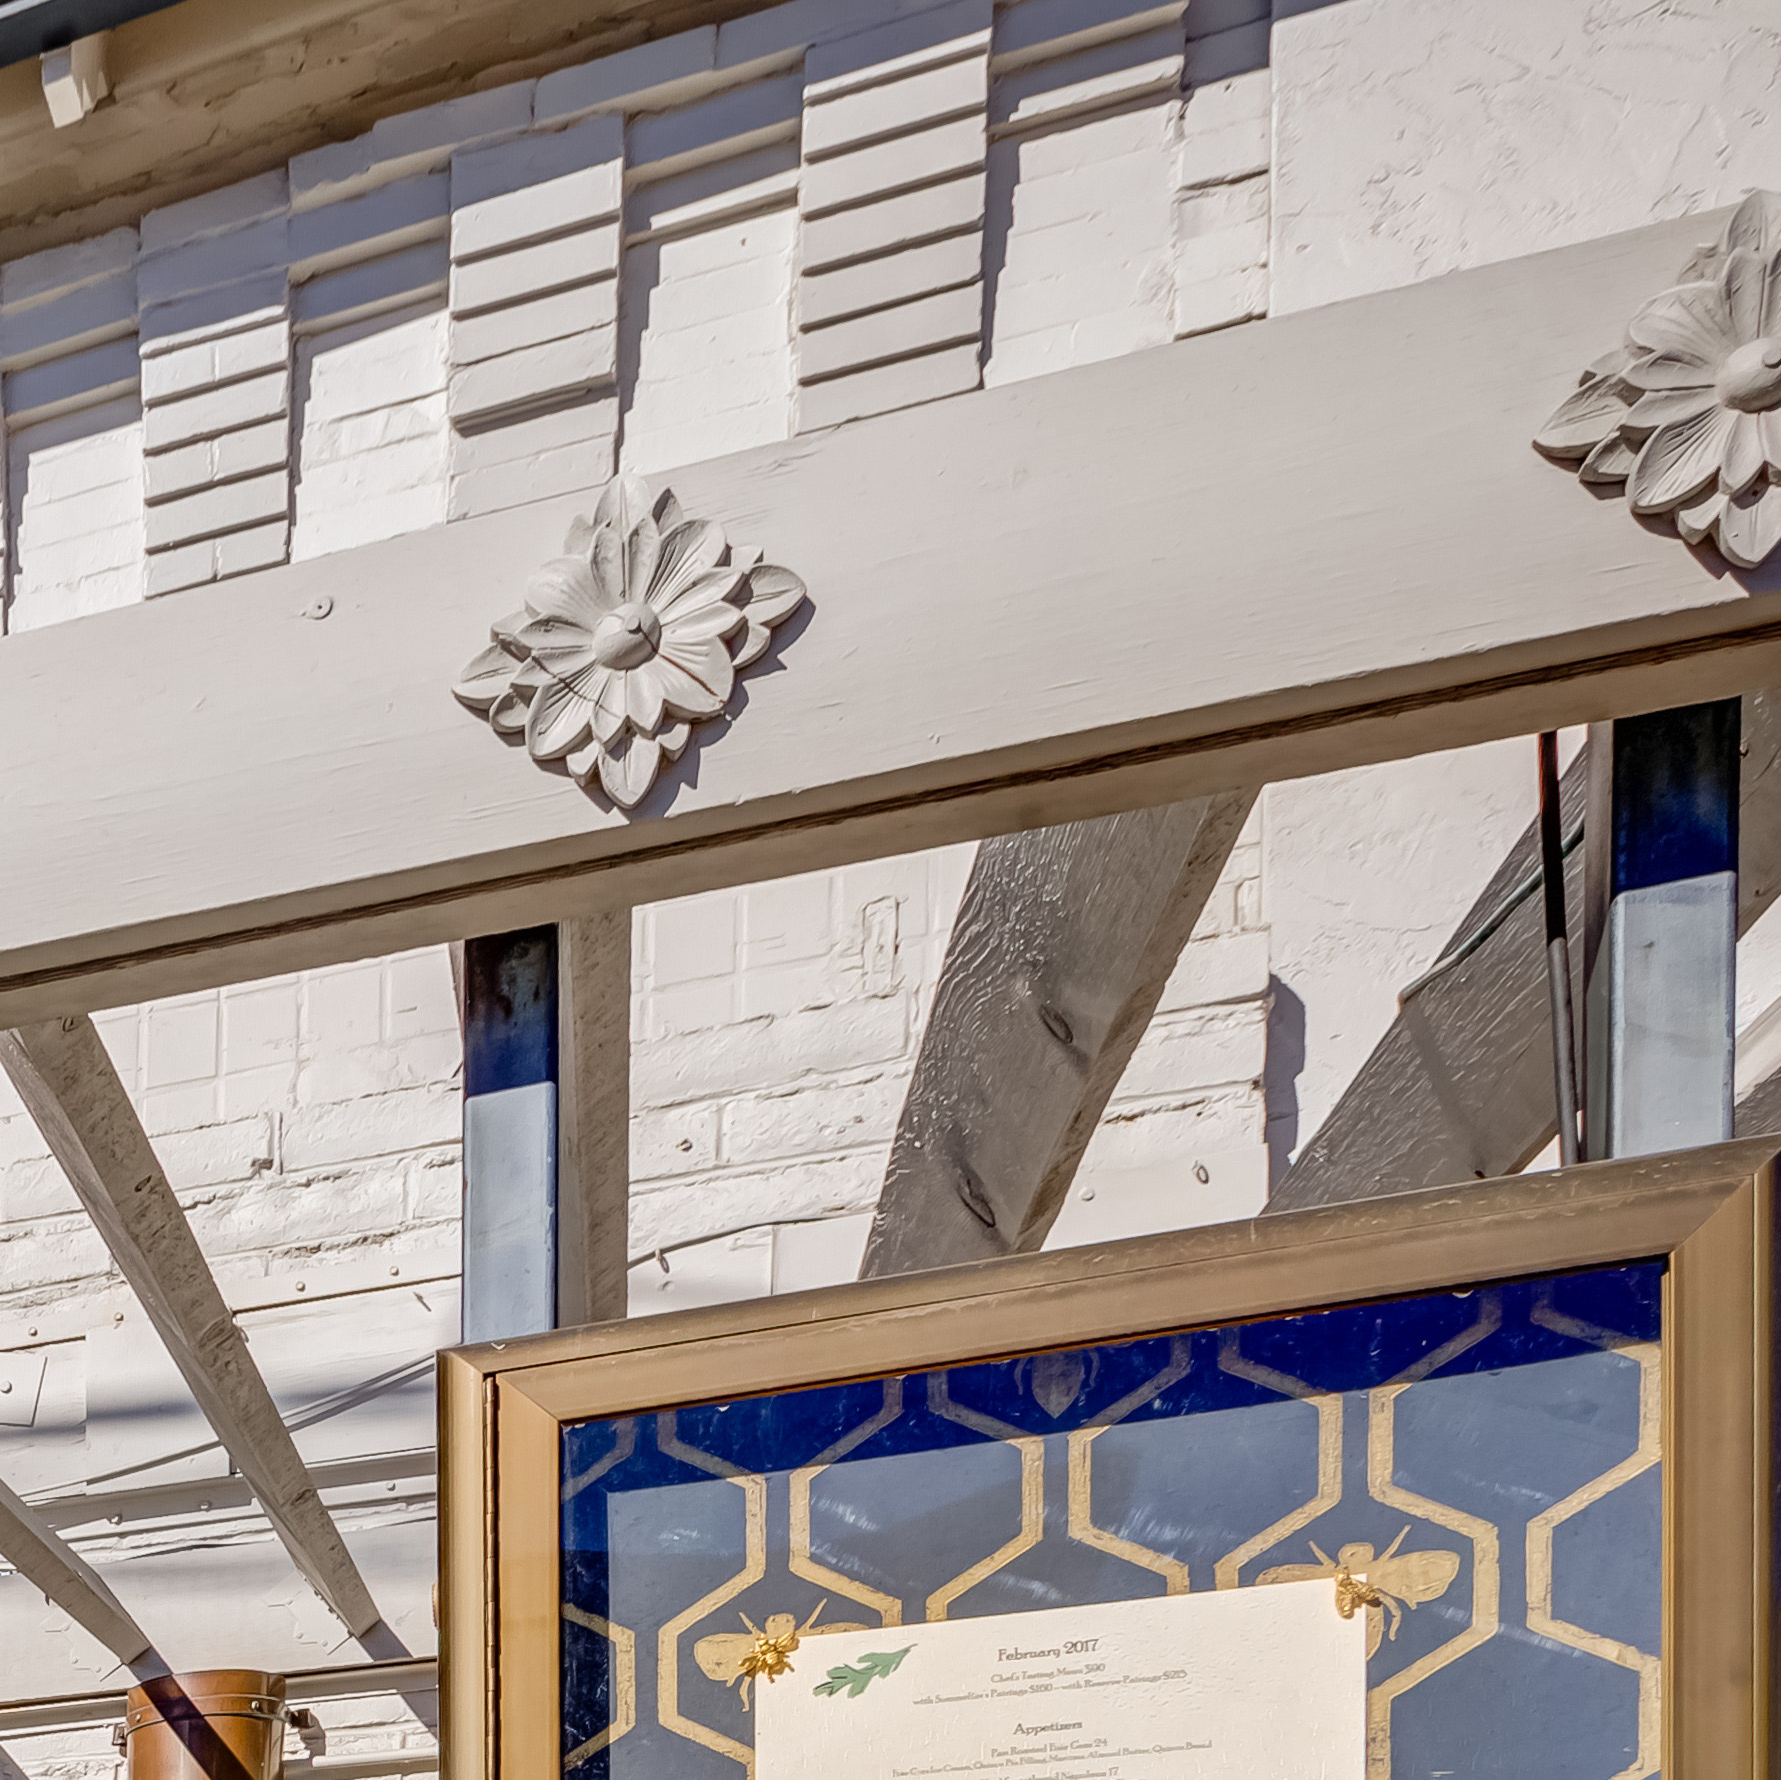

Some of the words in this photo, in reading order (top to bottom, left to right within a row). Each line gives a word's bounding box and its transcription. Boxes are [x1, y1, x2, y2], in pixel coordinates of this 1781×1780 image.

[998, 1643, 1060, 1664] February
[1062, 1638, 1099, 1655] 2017
[1013, 1718, 1082, 1738] Appetizers
[1094, 1737, 1107, 1748] 24
[1108, 1766, 1119, 1777] 17
